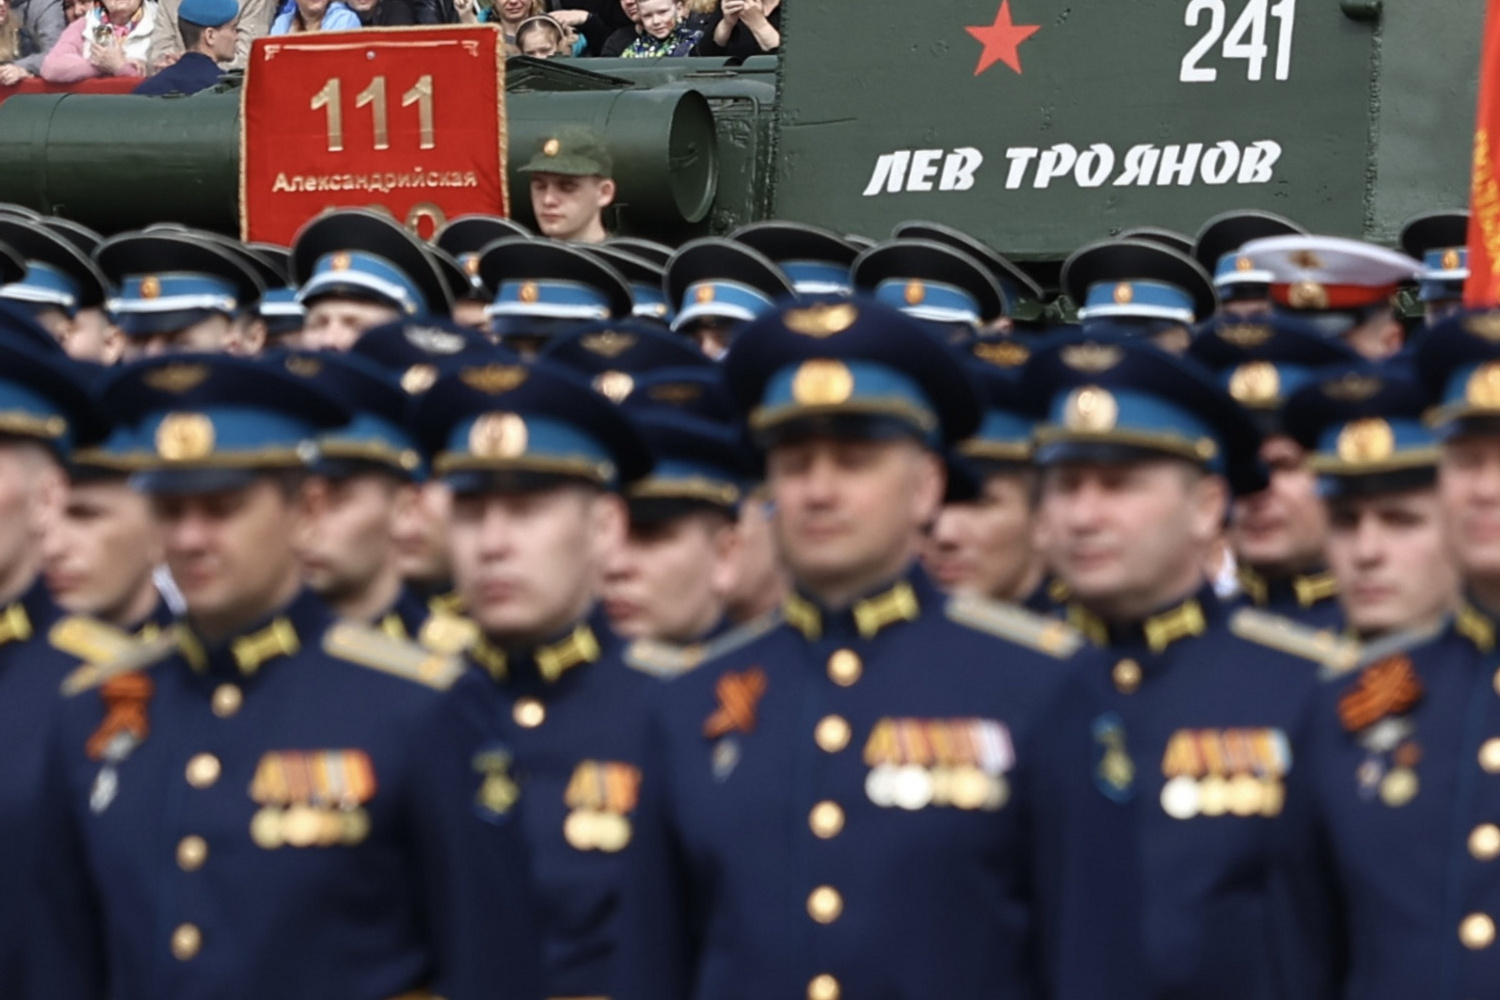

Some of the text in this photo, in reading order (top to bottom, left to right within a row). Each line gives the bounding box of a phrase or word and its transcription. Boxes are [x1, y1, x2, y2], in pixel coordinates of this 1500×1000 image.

[310, 74, 435, 152] 111
[272, 166, 478, 194] Александрийская
[863, 139, 1282, 196] ЛЕВ ТРОЯНОВ
